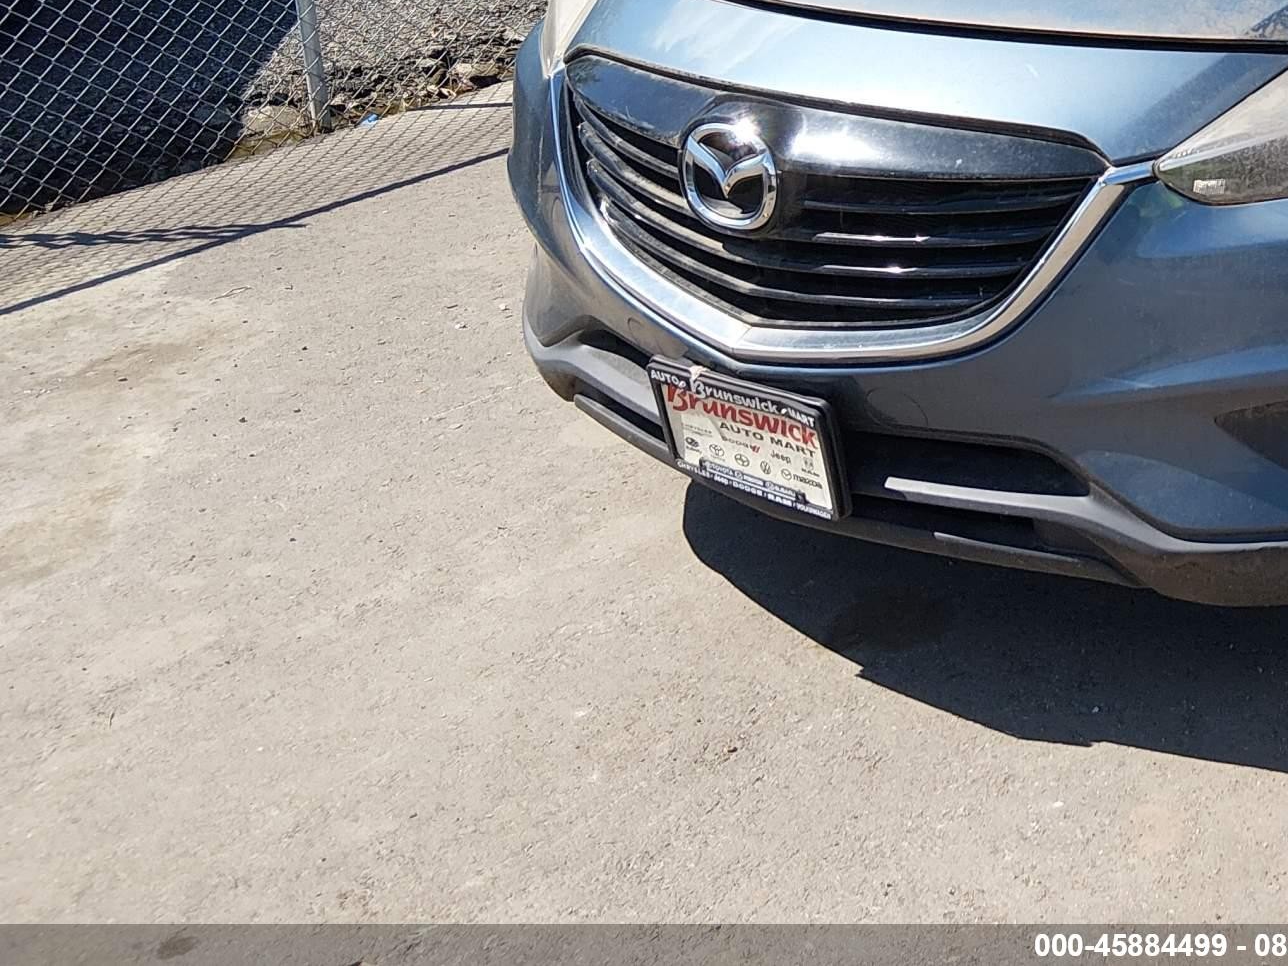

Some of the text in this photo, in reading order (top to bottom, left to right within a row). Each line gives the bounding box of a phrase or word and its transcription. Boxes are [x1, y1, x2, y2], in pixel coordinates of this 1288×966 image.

[650, 369, 680, 386] AUTO
[689, 377, 780, 414] Brunswick
[667, 383, 818, 450] Brunswick
[720, 422, 764, 441] AUTO
[770, 436, 816, 457] MART
